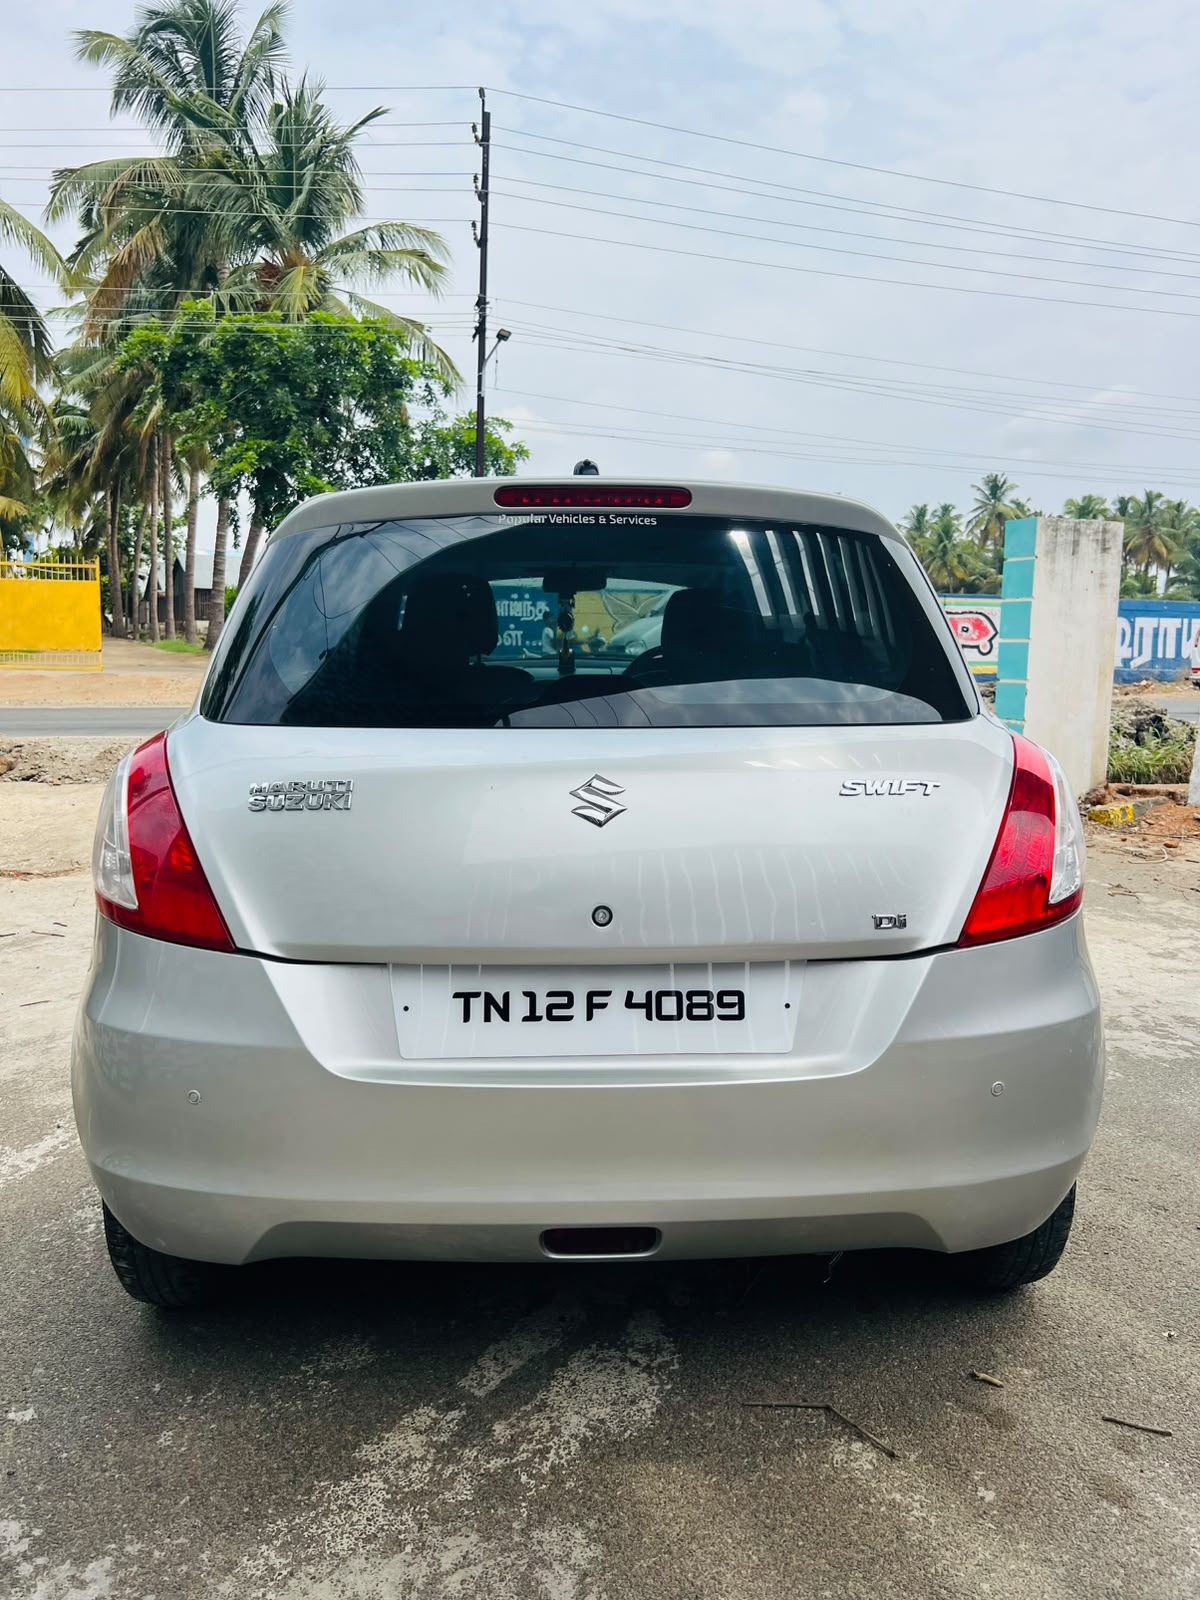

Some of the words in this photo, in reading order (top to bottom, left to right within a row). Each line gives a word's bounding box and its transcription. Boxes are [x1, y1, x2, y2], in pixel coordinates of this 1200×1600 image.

[498, 513, 548, 527] Popular
[548, 513, 596, 525] Vehicles
[598, 514, 607, 525] &
[609, 514, 658, 526] Services
[249, 779, 354, 795] MARUTI
[839, 778, 942, 797] SWIFT
[247, 793, 352, 812] SUZUKI
[451, 990, 511, 1024] TN
[521, 990, 575, 1023] 12
[585, 989, 613, 1022] F
[623, 989, 746, 1022] 4089
